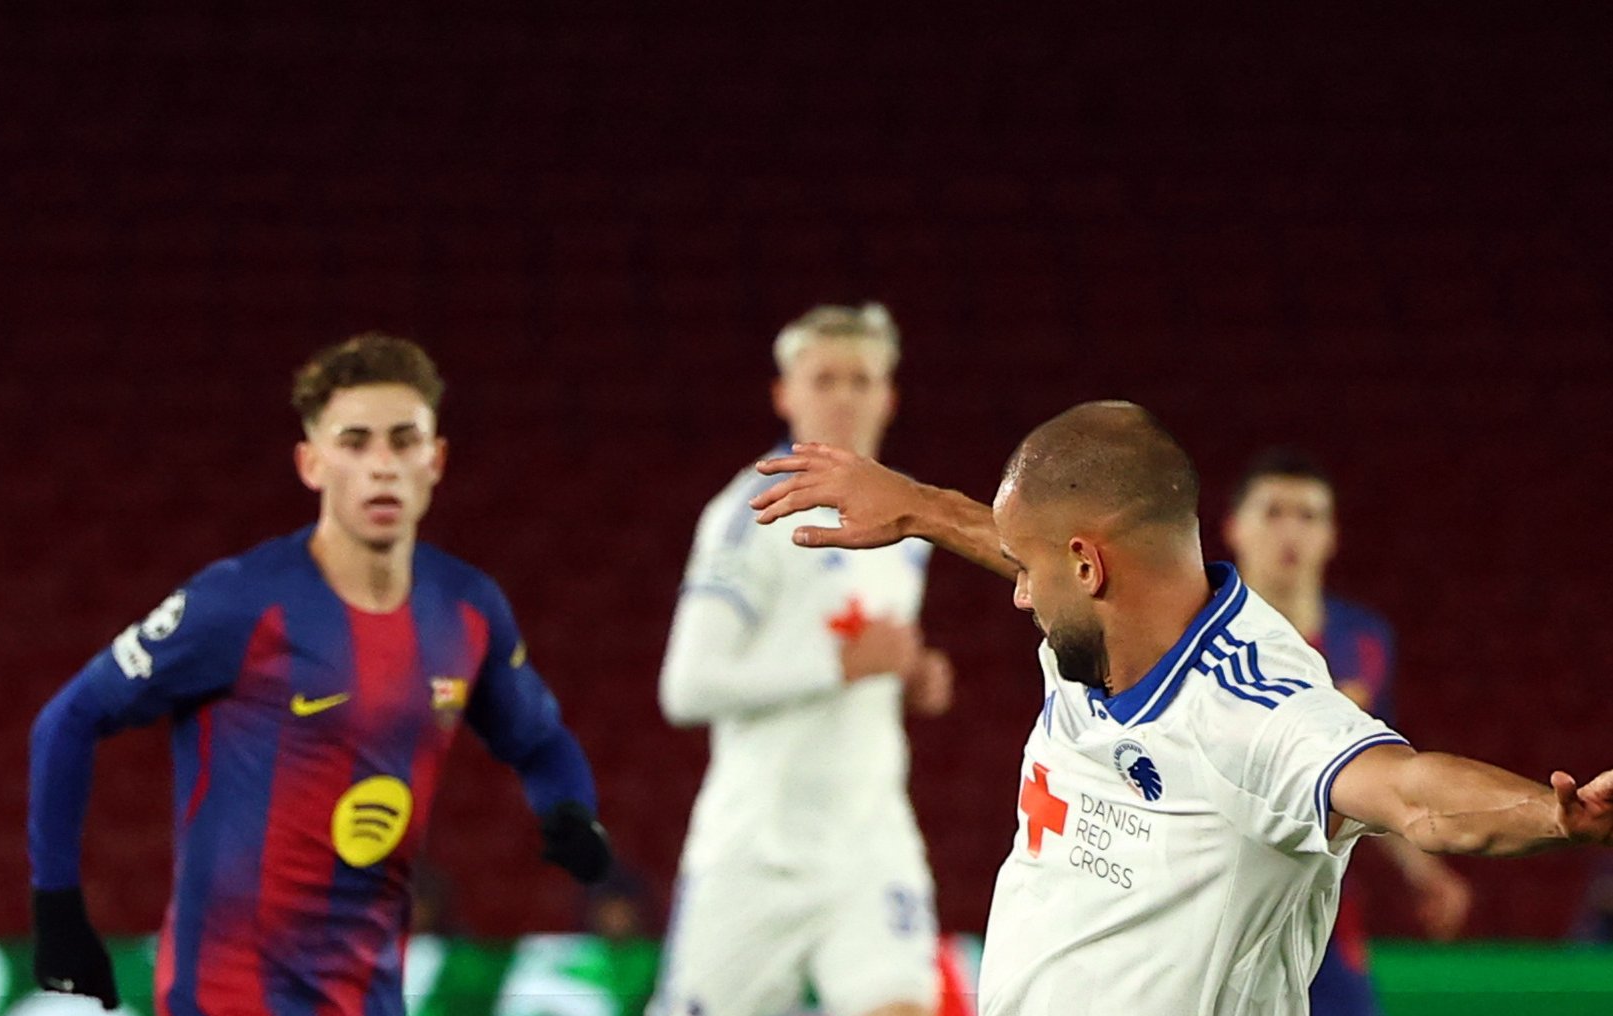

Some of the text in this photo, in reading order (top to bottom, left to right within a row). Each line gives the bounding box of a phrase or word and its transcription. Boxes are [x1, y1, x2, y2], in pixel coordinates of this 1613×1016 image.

[1075, 817, 1112, 852] RED
[1080, 792, 1152, 843] DANISH
[1068, 845, 1135, 890] CROSS
